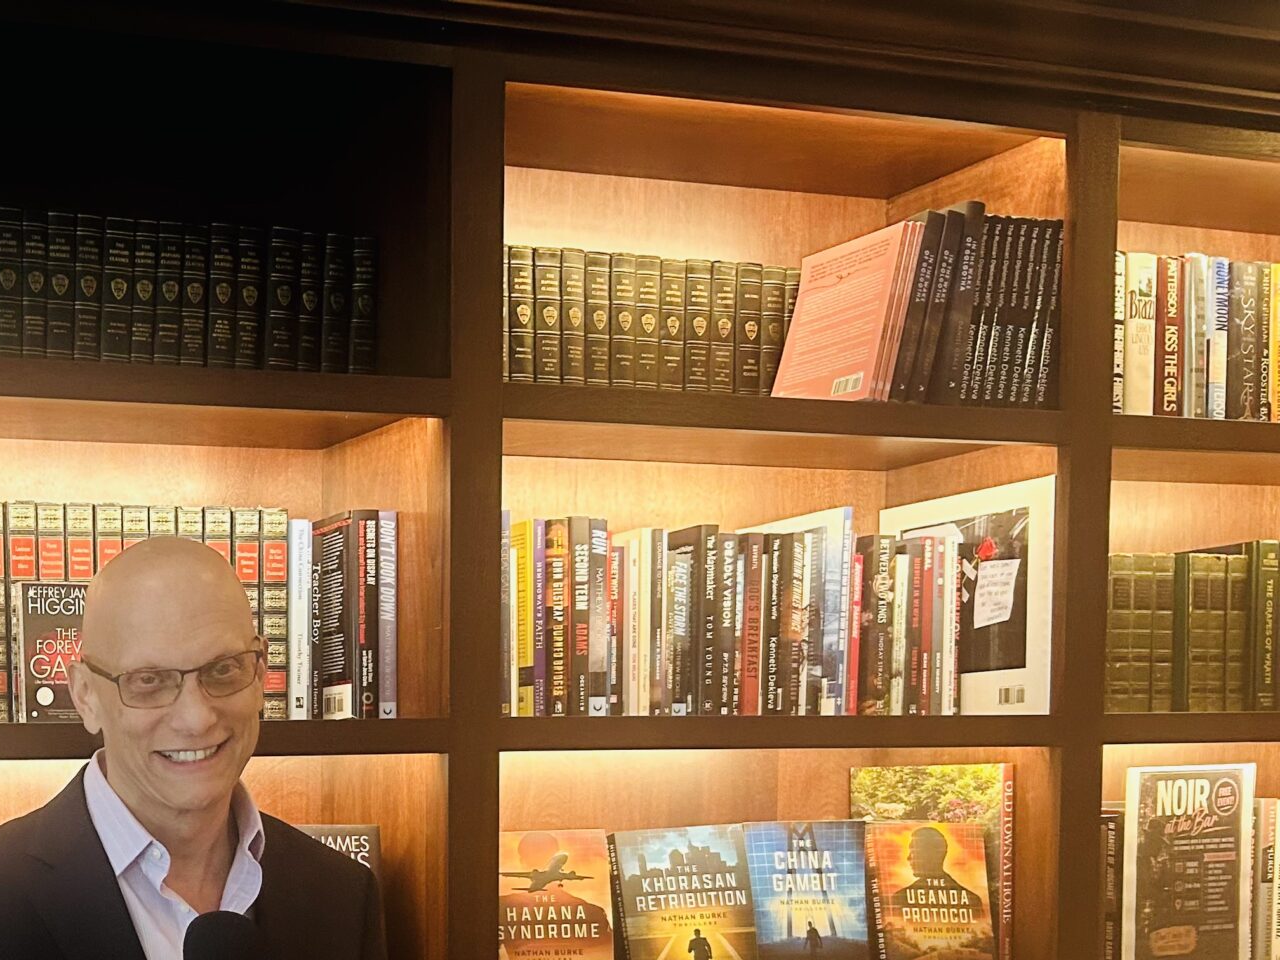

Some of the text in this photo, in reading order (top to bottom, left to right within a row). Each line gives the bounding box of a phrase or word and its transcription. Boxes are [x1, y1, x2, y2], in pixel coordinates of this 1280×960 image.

[1003, 324, 1014, 362] Kenneth
[1165, 326, 1178, 354] KISS
[1164, 353, 1177, 376] THE
[1164, 378, 1176, 412] GIRLS
[591, 529, 606, 555] RUN
[380, 520, 396, 621] DON'T LOOK DOWN
[575, 544, 589, 610] SECOND TERM
[706, 535, 717, 600] The Mapmaker
[28, 586, 66, 598] JEFFREY
[722, 540, 735, 628] DEADLY VISION
[311, 562, 321, 644] Teacher Boy
[56, 628, 77, 640] THE
[575, 623, 588, 656] ADAMS
[36, 640, 82, 654] FOREV
[747, 620, 759, 679] BREAKFAST
[1156, 779, 1210, 816] NOIR
[1191, 808, 1219, 836] Bar
[792, 840, 811, 848] THE
[676, 865, 697, 873] THE
[775, 850, 833, 870] CHINA
[642, 873, 736, 892] KHORASAN
[773, 873, 837, 892] GAMBIT
[636, 890, 746, 911] RETRIBUTION
[906, 889, 969, 904] UGANDA
[506, 905, 586, 921] HAVANA
[661, 912, 727, 921] NATHAN BURKE
[902, 907, 977, 924] PROTOCOL
[499, 924, 600, 940] SYNDROME
